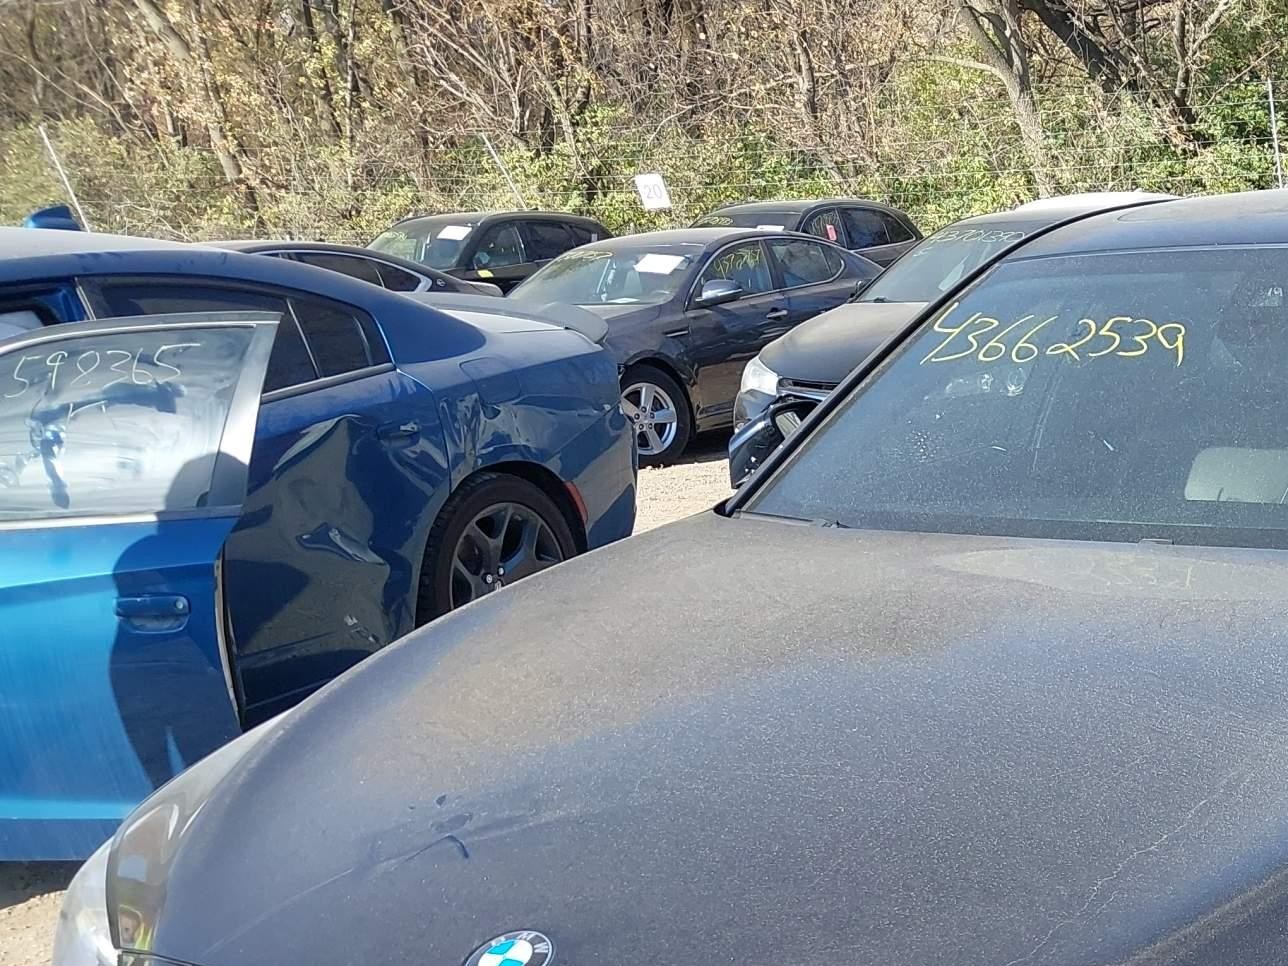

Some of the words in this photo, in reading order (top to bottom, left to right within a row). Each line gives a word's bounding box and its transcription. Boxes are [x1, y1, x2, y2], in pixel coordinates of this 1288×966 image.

[643, 183, 663, 199] 20
[920, 302, 1186, 367] 43662539
[3, 343, 202, 399] 598365
